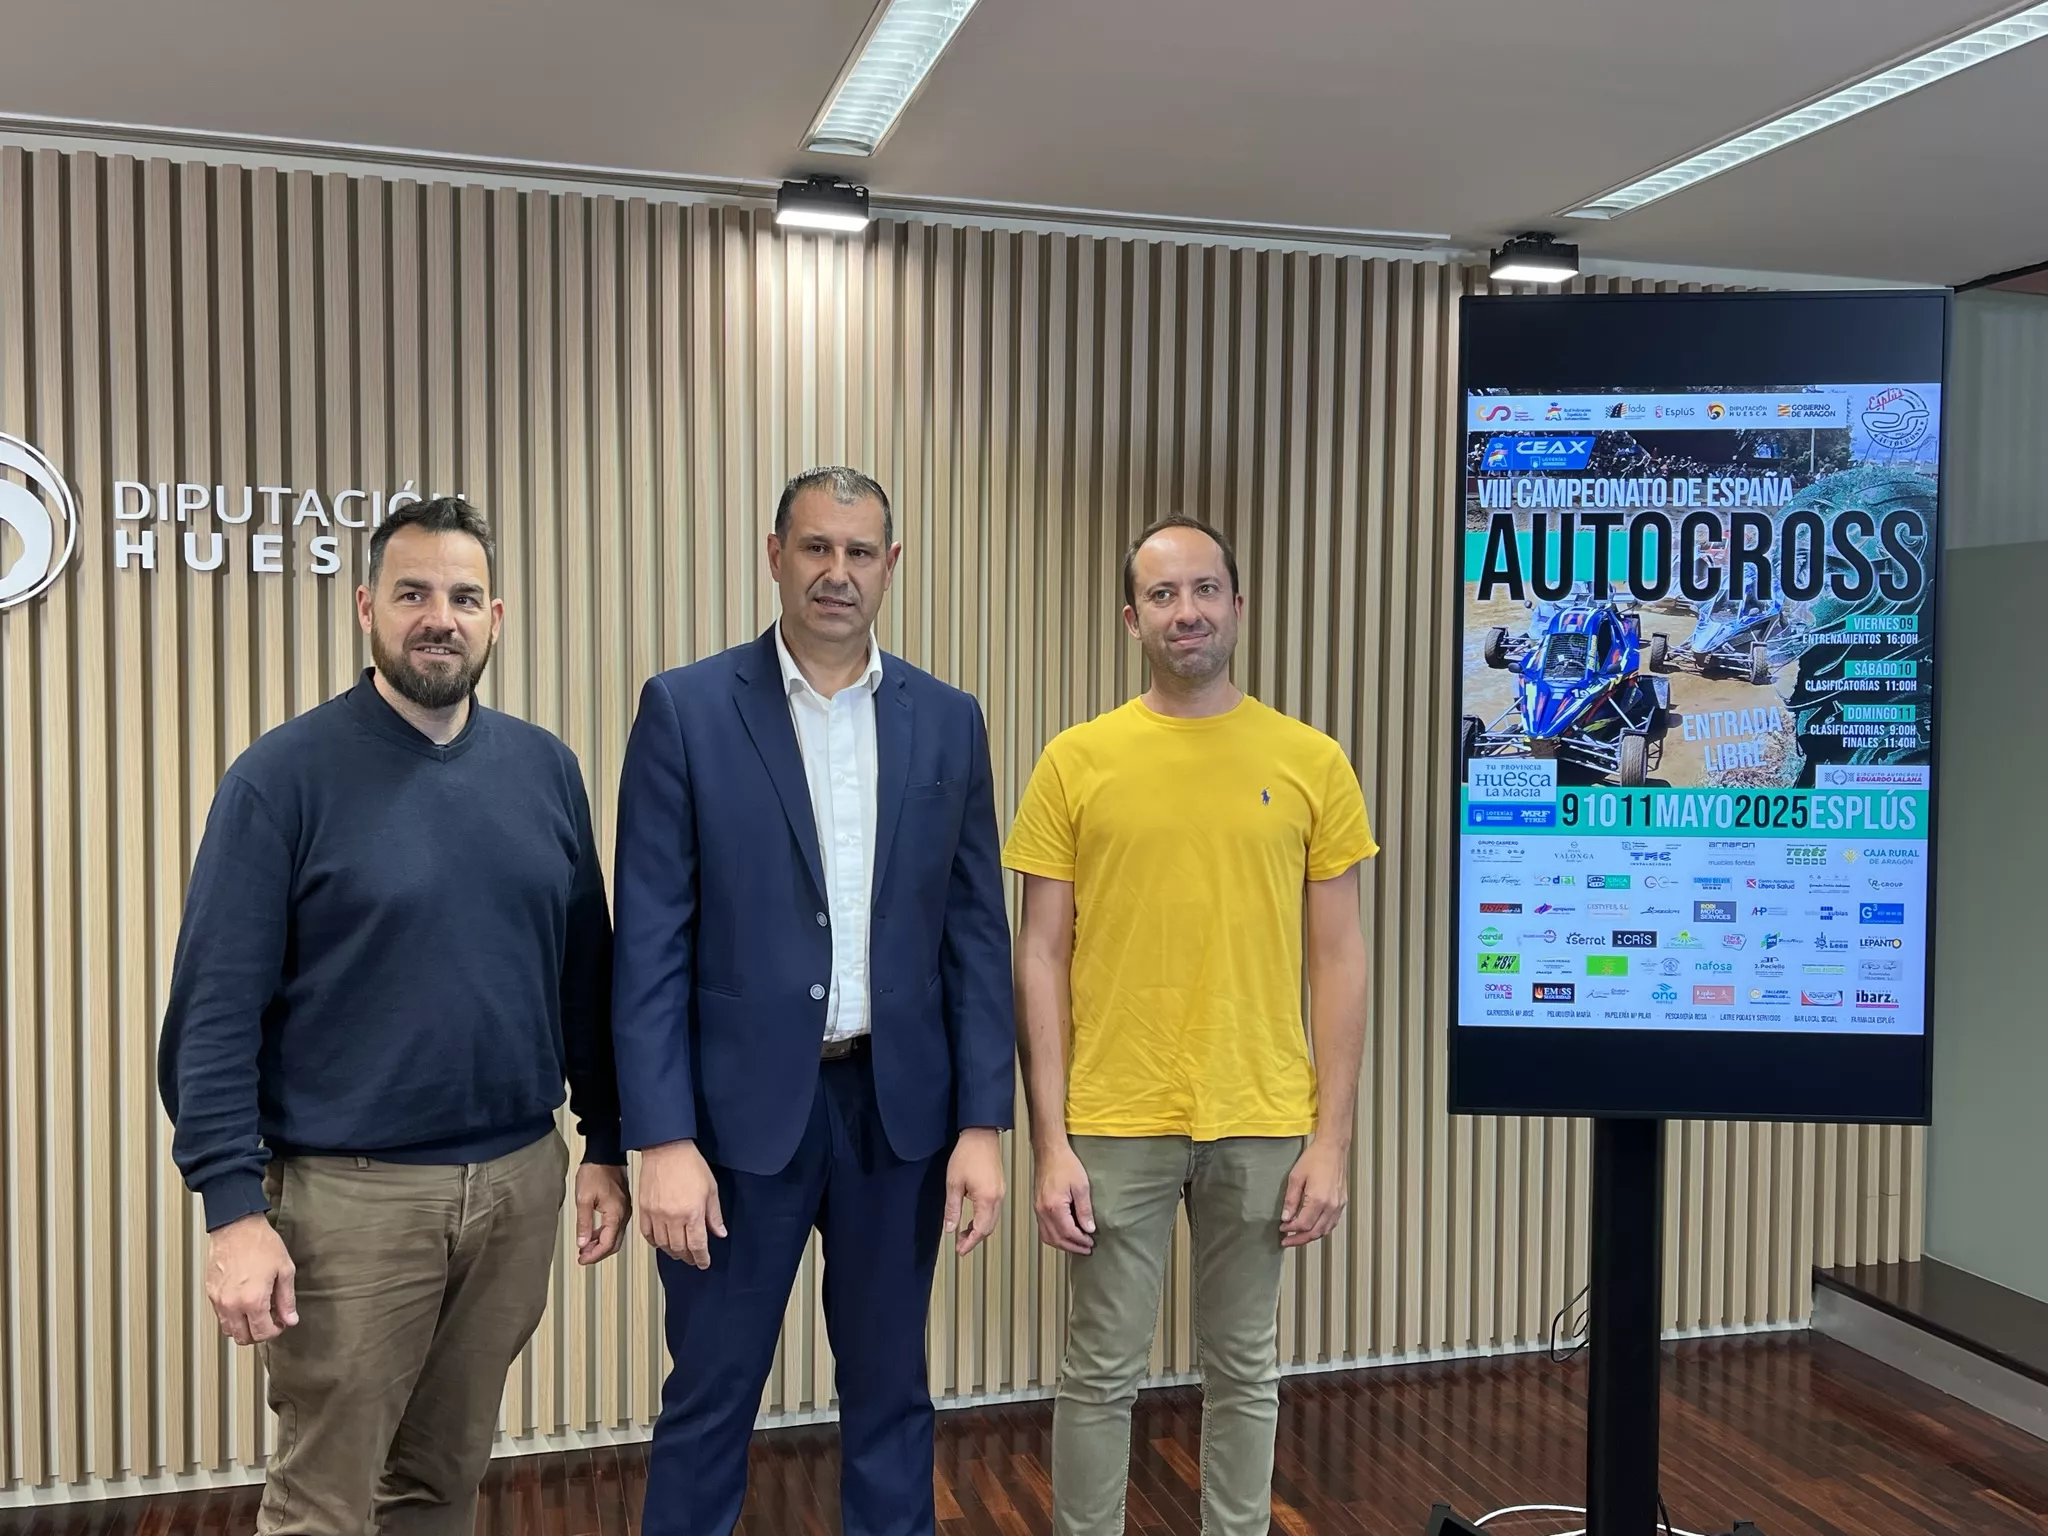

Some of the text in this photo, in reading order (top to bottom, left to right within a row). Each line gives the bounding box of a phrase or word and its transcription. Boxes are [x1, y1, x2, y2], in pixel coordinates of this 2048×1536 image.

[1628, 404, 1646, 413] fada
[1516, 440, 1588, 454] CEAX
[1478, 476, 1794, 508] VIII CAMPEONATO DE ESPAÑA
[114, 480, 466, 528] DIPUTACIÓ
[114, 529, 371, 575] HUES
[1477, 509, 1928, 602] AUTOCROSS
[1854, 617, 1913, 630] VIERNES 09
[1802, 633, 1918, 645] ENTRENAMIENTOS 16:00H
[1854, 660, 1912, 675] SÁBADO 10
[1805, 680, 1917, 691] CLASIFICATORIAS 11:00H
[1848, 707, 1911, 720] DOMINGO 11
[1682, 706, 1783, 741] ENTRADA
[1810, 724, 1917, 736] CLASIFICATORIAS 9:00H
[1842, 737, 1916, 748] FINALES 11:40H
[1704, 740, 1767, 771] LIBRE
[1562, 785, 1917, 830] 9 10 11 MAYO 2025 ESPLÚS
[1863, 849, 1920, 857] CAJA RURAL
[1552, 875, 1576, 885] dial
[1571, 935, 1606, 945] serrat
[1860, 938, 1903, 949] LEPANTO
[1695, 960, 1733, 971] nafosa
[1652, 991, 1678, 1000] ona
[1856, 989, 1891, 1003] ibarz
[1604, 1011, 1630, 1019] PAPELERÍA
